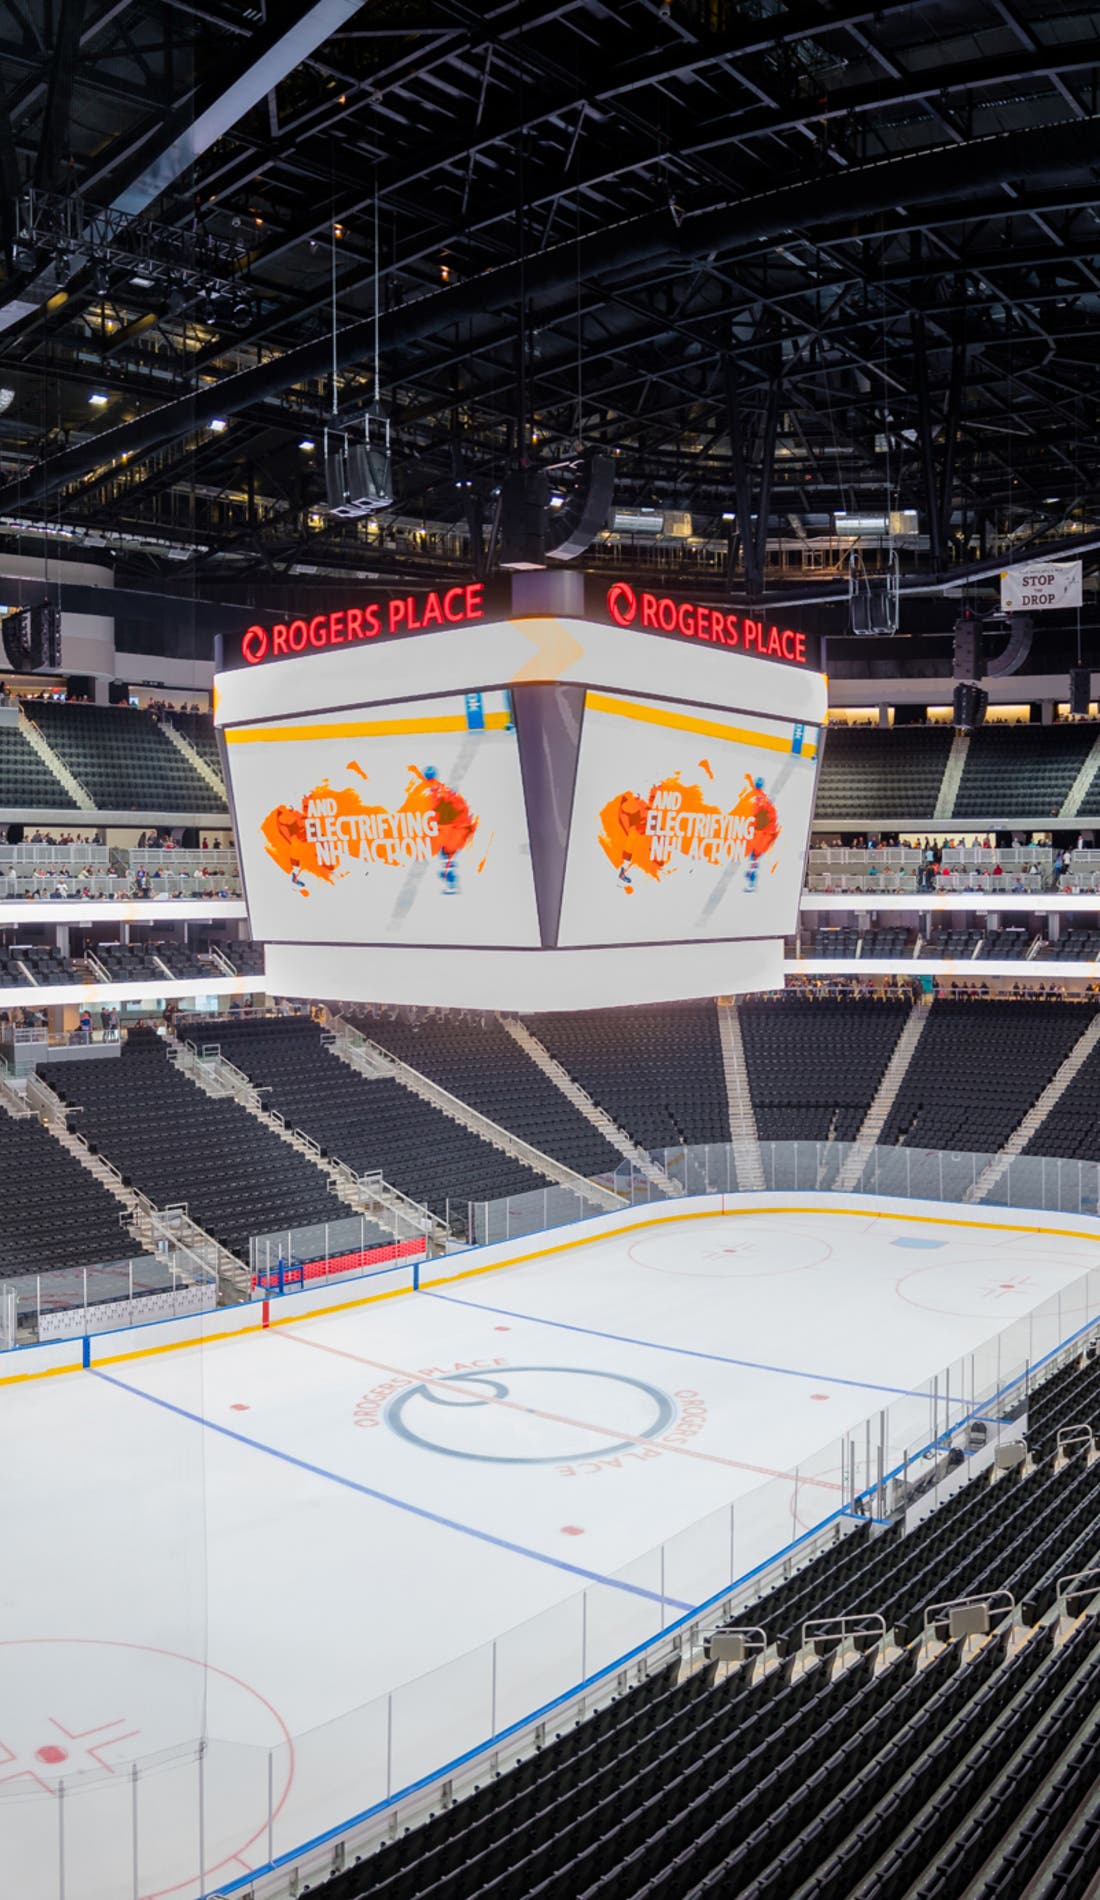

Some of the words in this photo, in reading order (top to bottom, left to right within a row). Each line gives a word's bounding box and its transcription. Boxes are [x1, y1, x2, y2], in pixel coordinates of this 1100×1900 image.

[1022, 574, 1055, 587] STOP
[1022, 593, 1056, 606] DROP
[272, 603, 381, 656] ROGERS
[388, 583, 485, 634] PLACE
[640, 593, 739, 646] ROGERS
[743, 619, 807, 663] PLACE
[307, 798, 337, 818] AND
[652, 789, 682, 811] AND
[304, 810, 440, 843] ELECTRIFYING
[645, 809, 756, 841] ELECTRIFYING
[418, 1357, 507, 1377] PLACE
